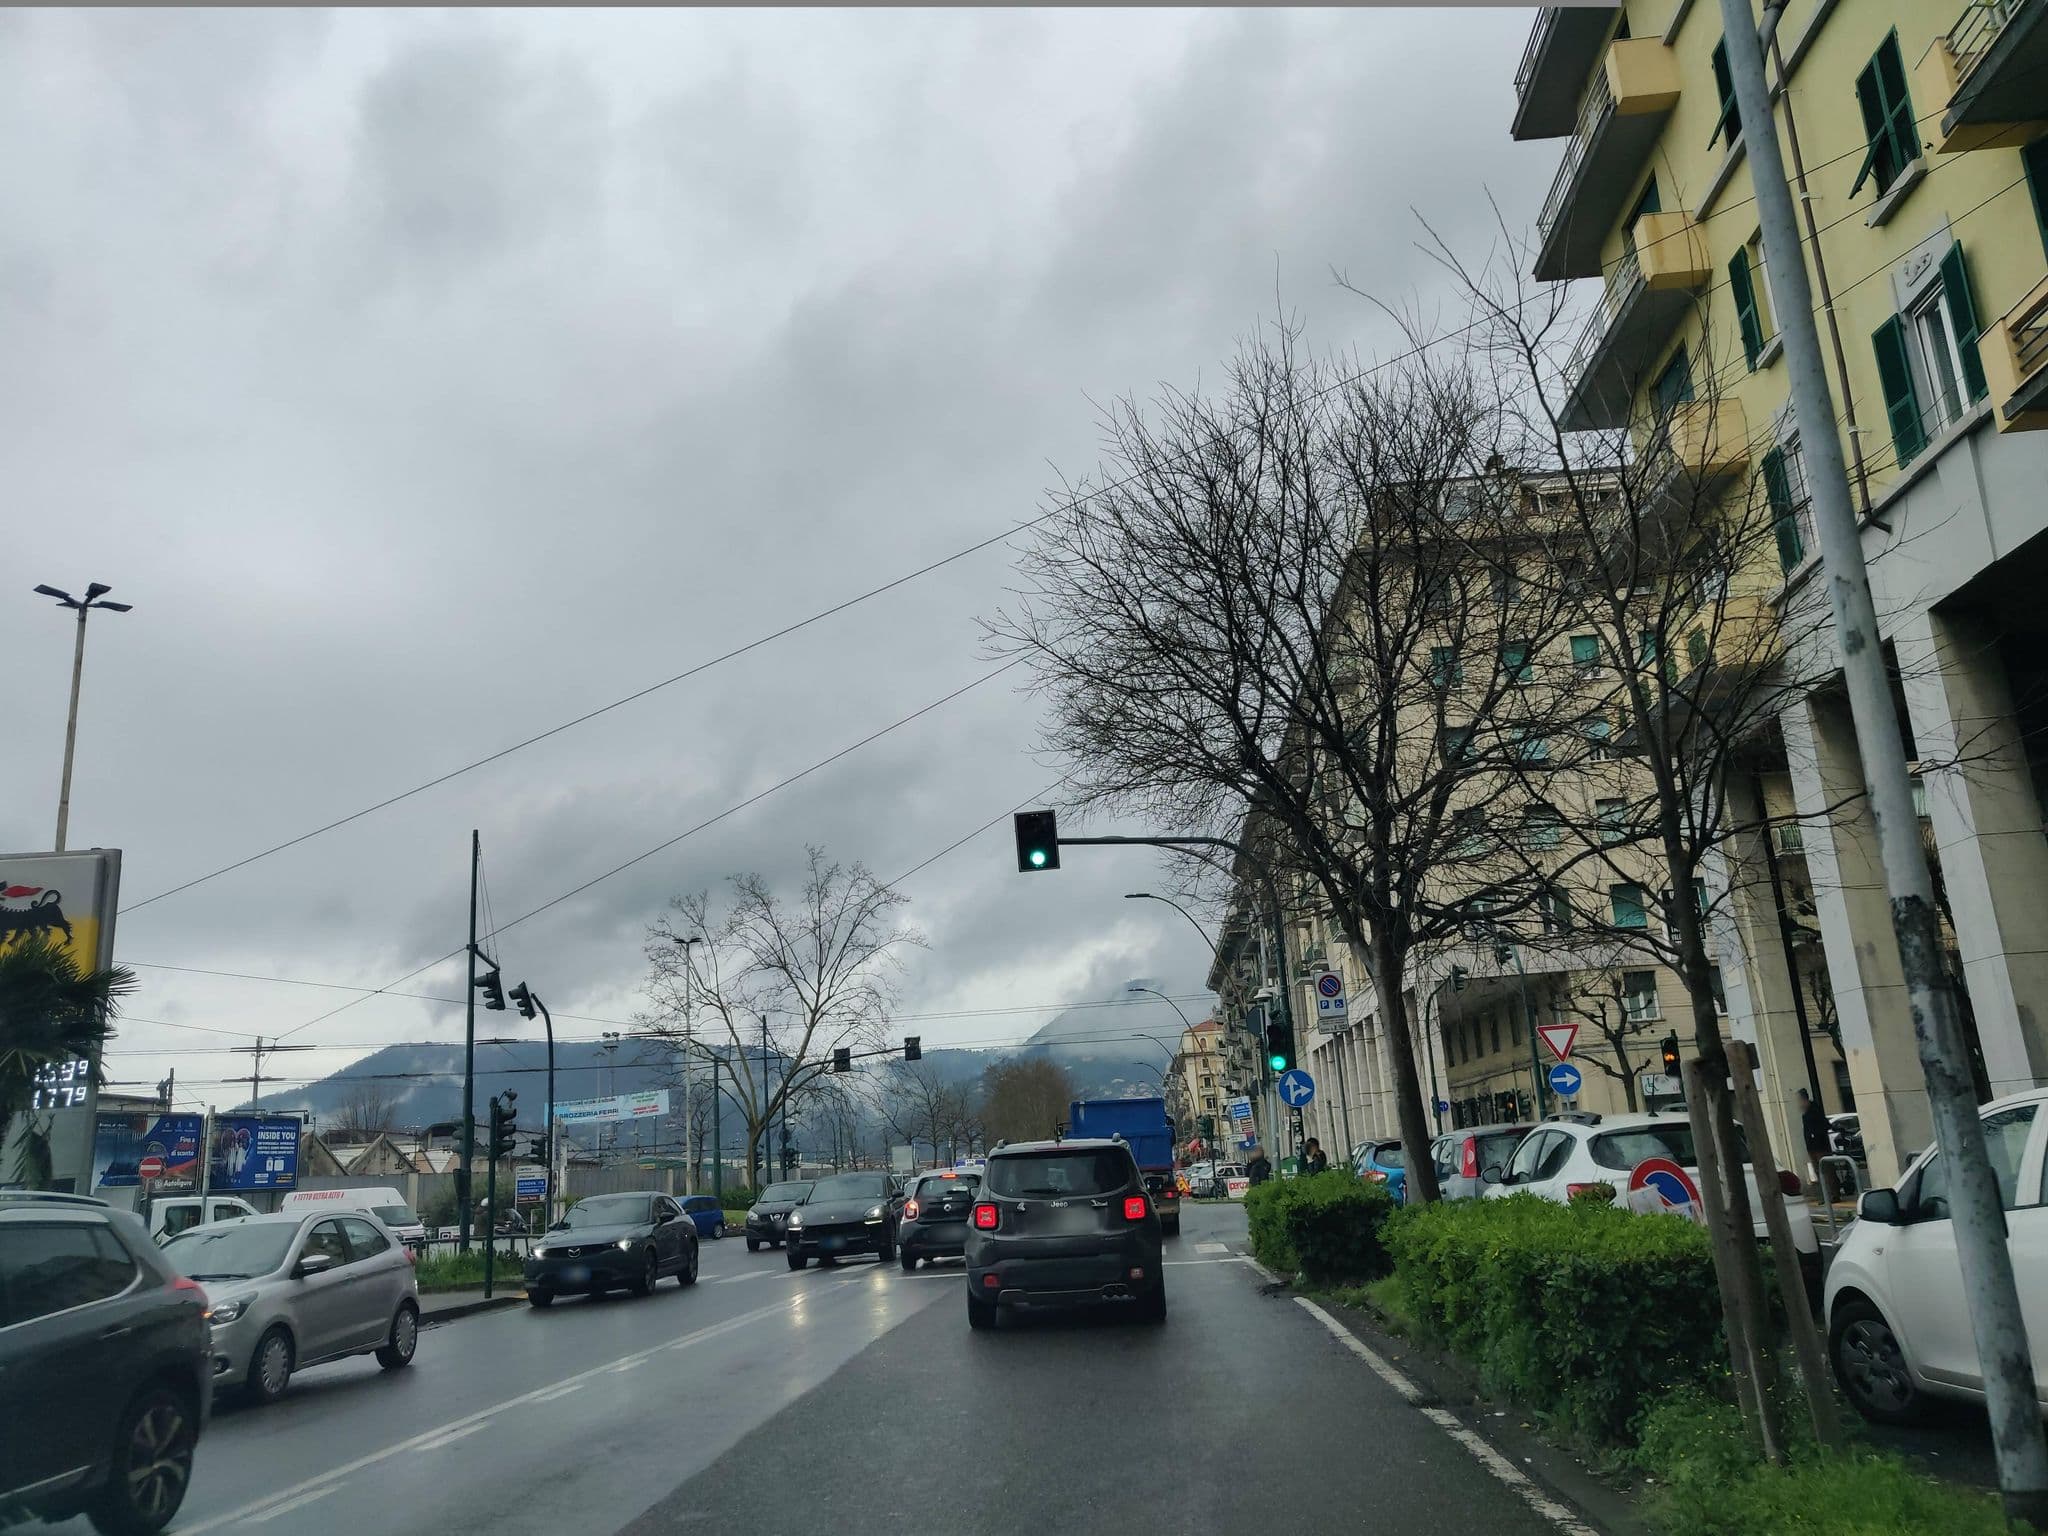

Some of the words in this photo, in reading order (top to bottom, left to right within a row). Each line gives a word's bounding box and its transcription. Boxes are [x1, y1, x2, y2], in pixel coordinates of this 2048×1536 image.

[257, 1131, 281, 1140] INSIDE
[282, 1131, 296, 1140] YOU
[298, 1193, 312, 1201] TETTO
[312, 1191, 328, 1200] ULTRA
[328, 1191, 341, 1199] ALTO
